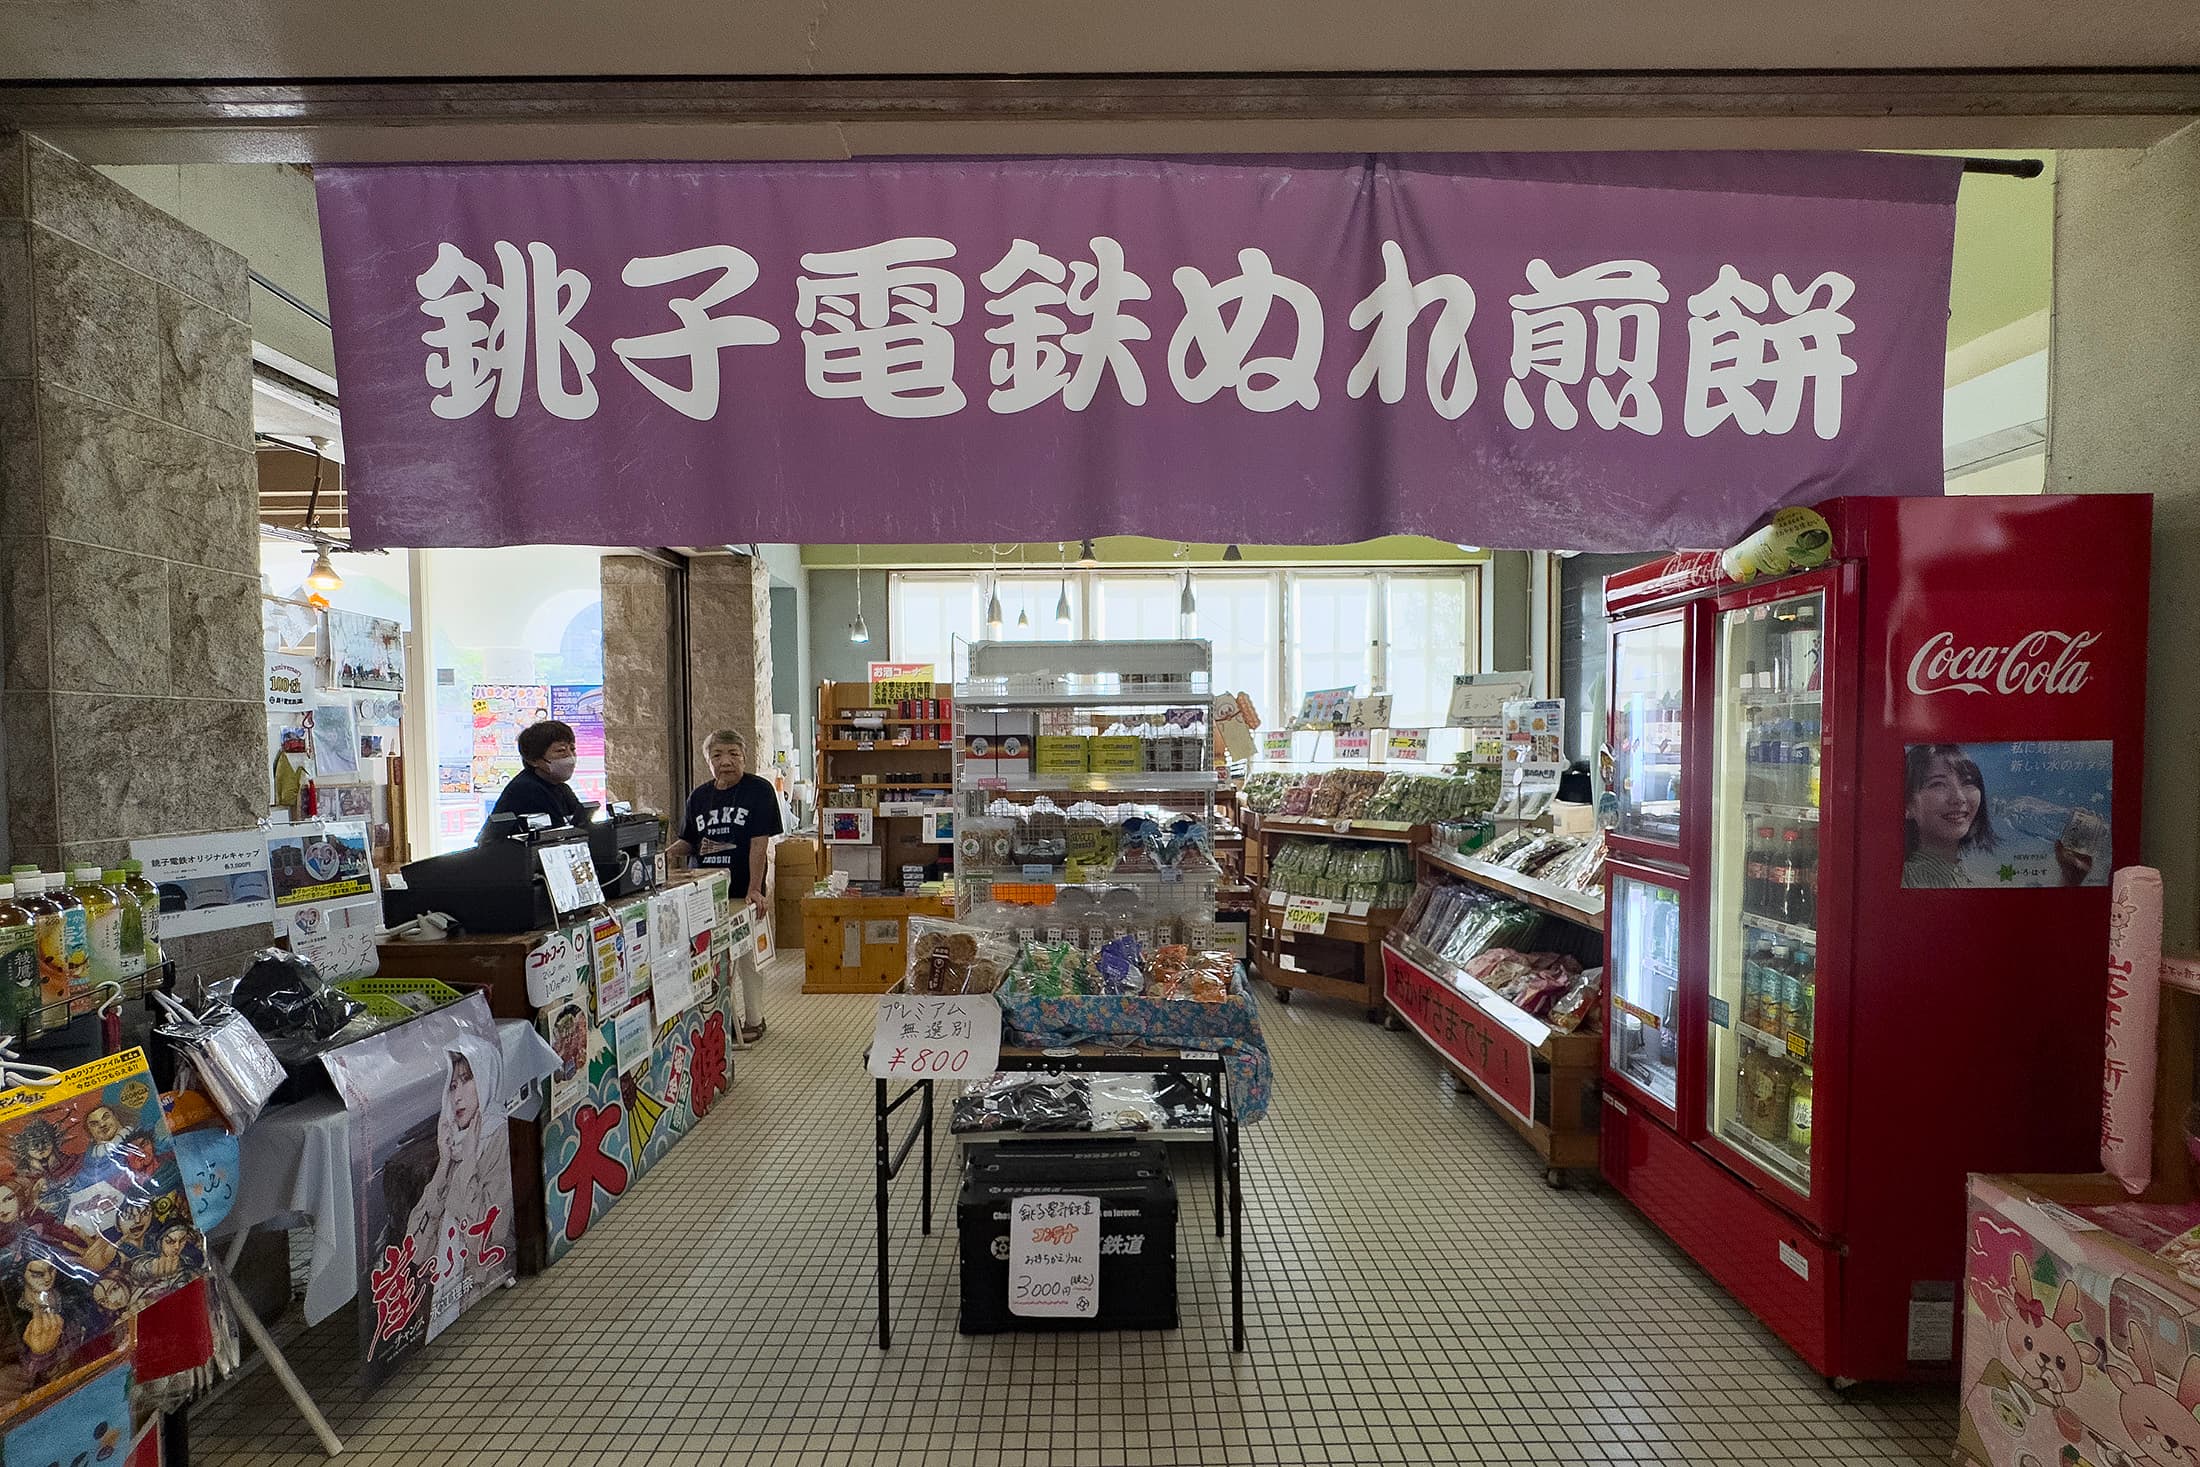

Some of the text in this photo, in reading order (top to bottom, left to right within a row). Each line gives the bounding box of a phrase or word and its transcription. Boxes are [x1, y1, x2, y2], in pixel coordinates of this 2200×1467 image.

[415, 236, 1858, 440] 銚子電鉄ぬれ煎餅
[873, 667, 932, 678] お酒コーナー
[1906, 630, 2103, 696] Coca-Cola
[695, 806, 750, 832] GAKE
[152, 849, 260, 868] 銚子電鉄オリジナルキャップ
[882, 1001, 967, 1022] プレミアム
[900, 1019, 972, 1041] 無選別
[64, 1058, 121, 1082] A4クリアファイル
[888, 1048, 969, 1073] ¥800
[1032, 1223, 1080, 1245] コンテナ
[1101, 1233, 1146, 1256] 鉄道
